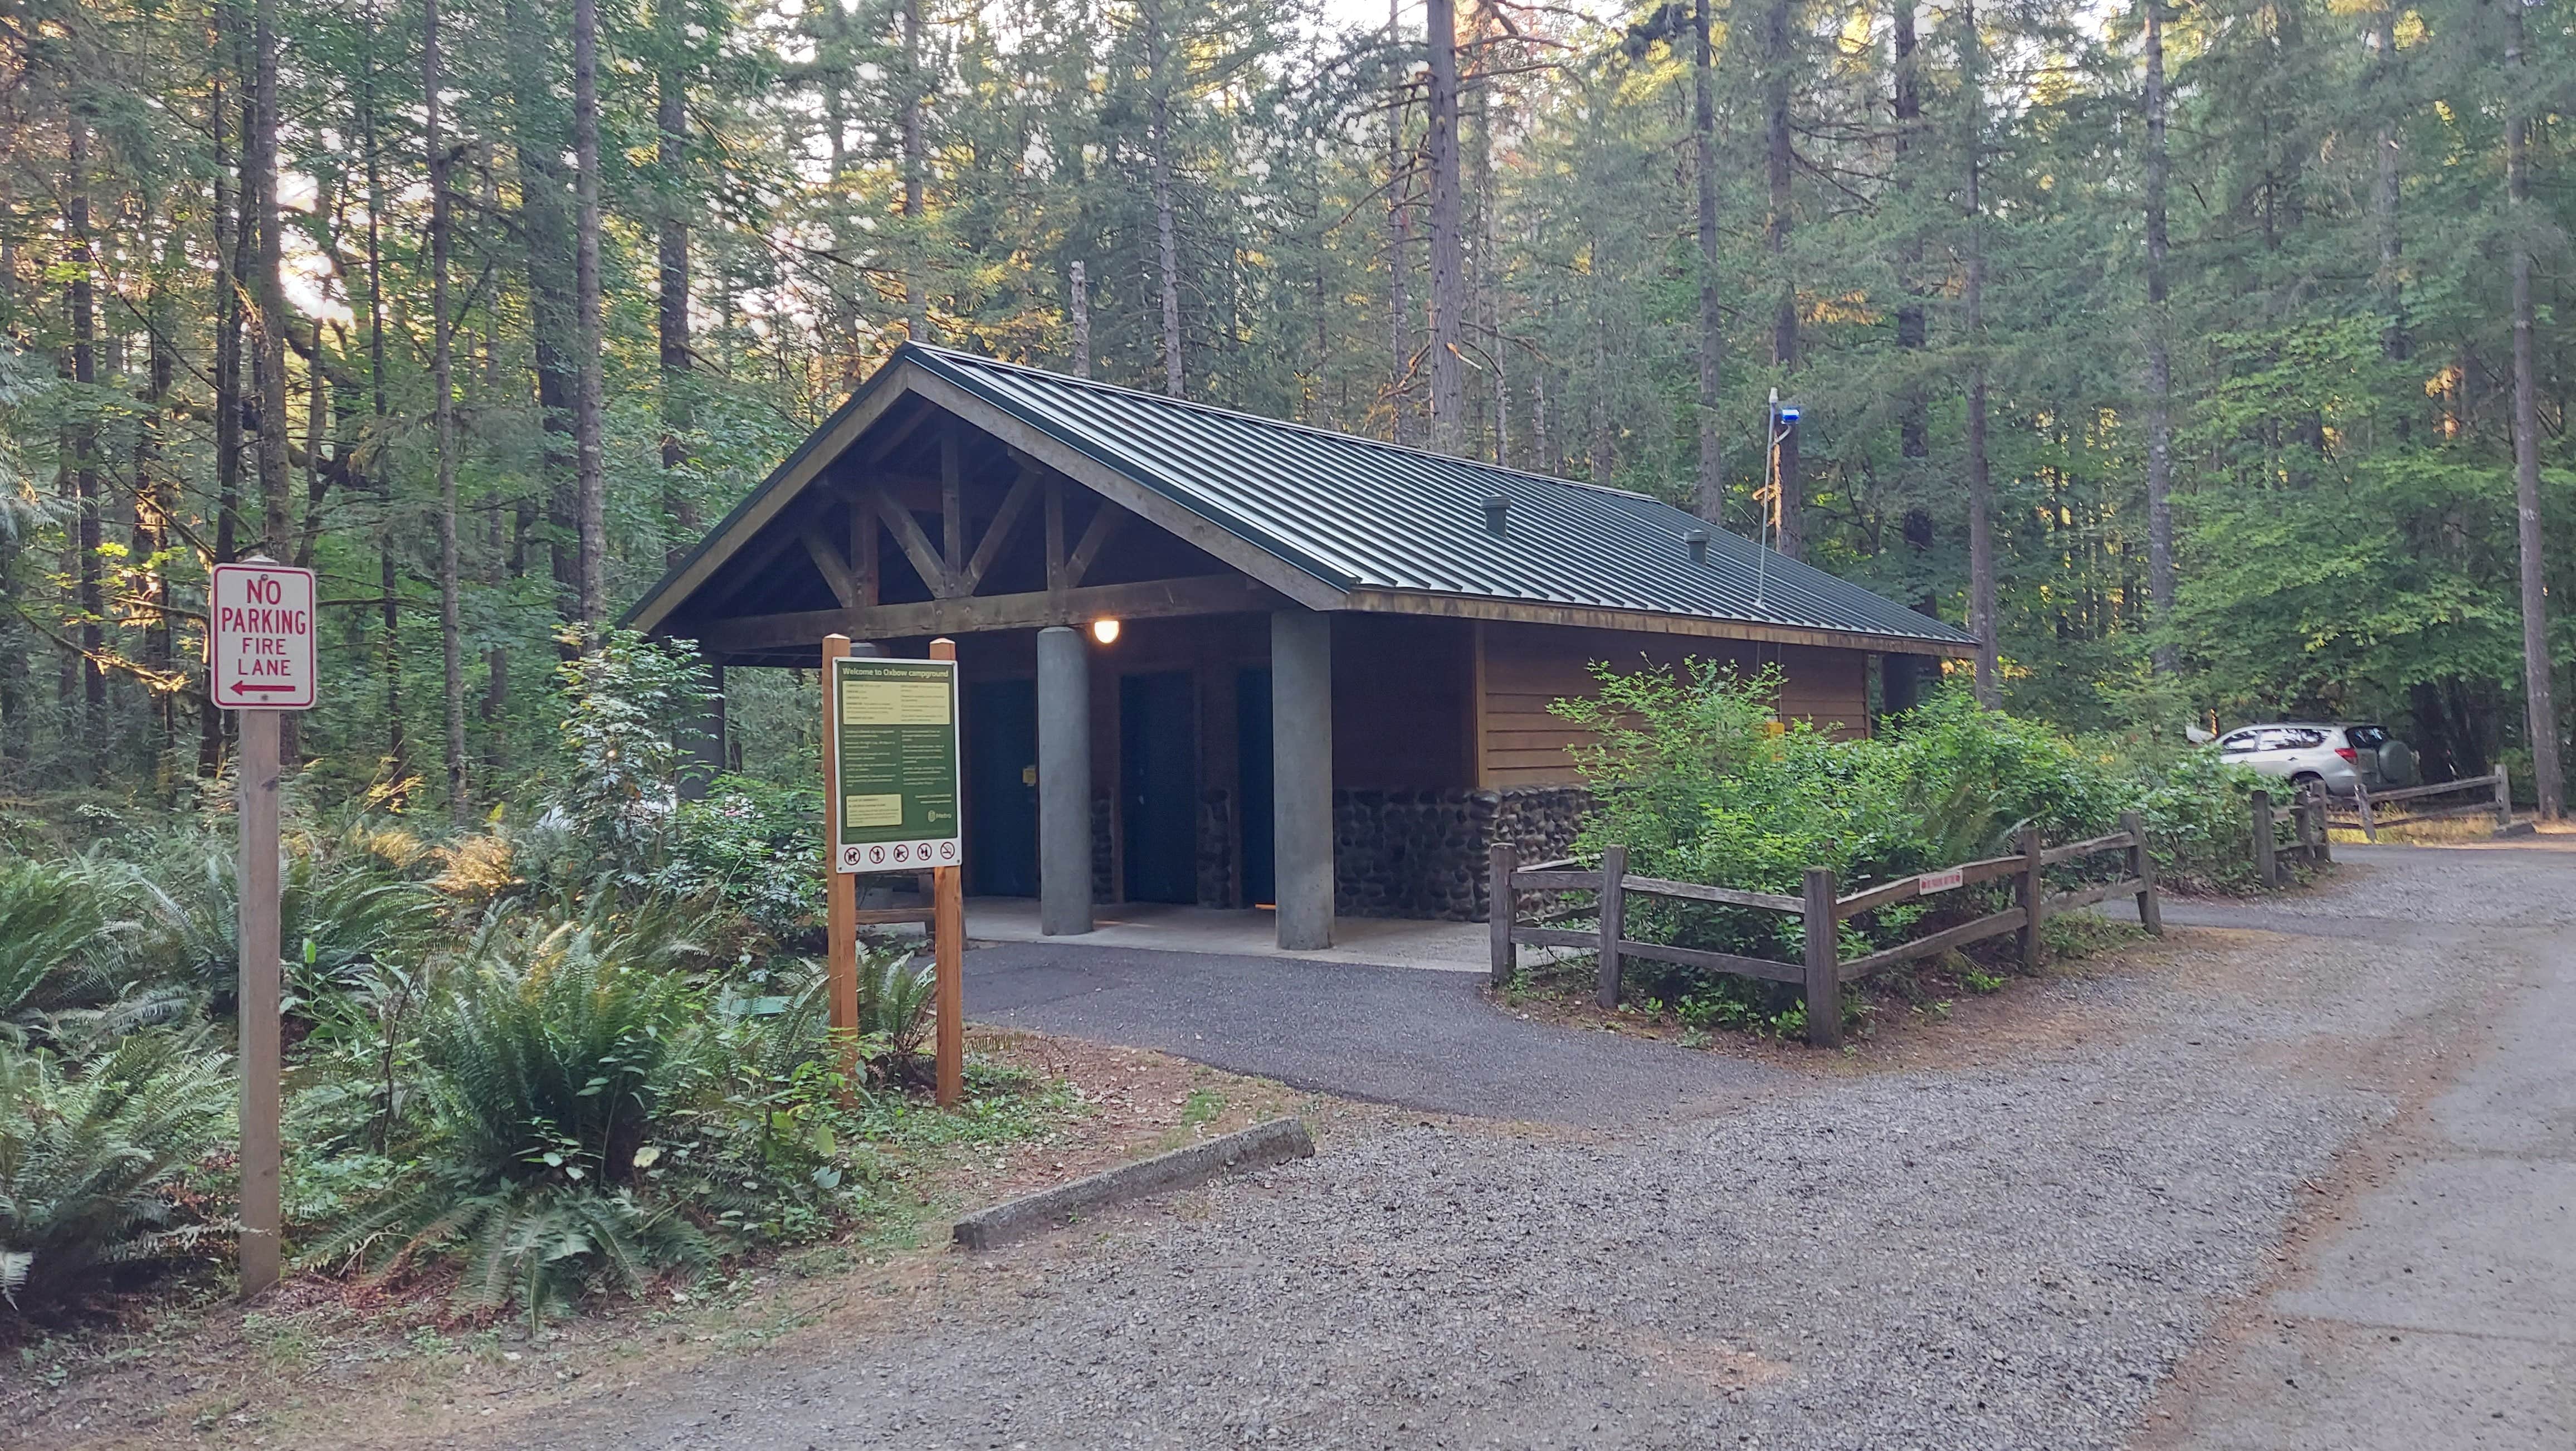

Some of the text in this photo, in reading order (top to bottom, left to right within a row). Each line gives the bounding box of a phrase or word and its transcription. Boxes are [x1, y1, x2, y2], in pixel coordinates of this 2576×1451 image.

[247, 579, 281, 605] NO
[222, 607, 306, 635] PARKING
[242, 637, 286, 655] FIRE
[238, 659, 291, 676] LANE
